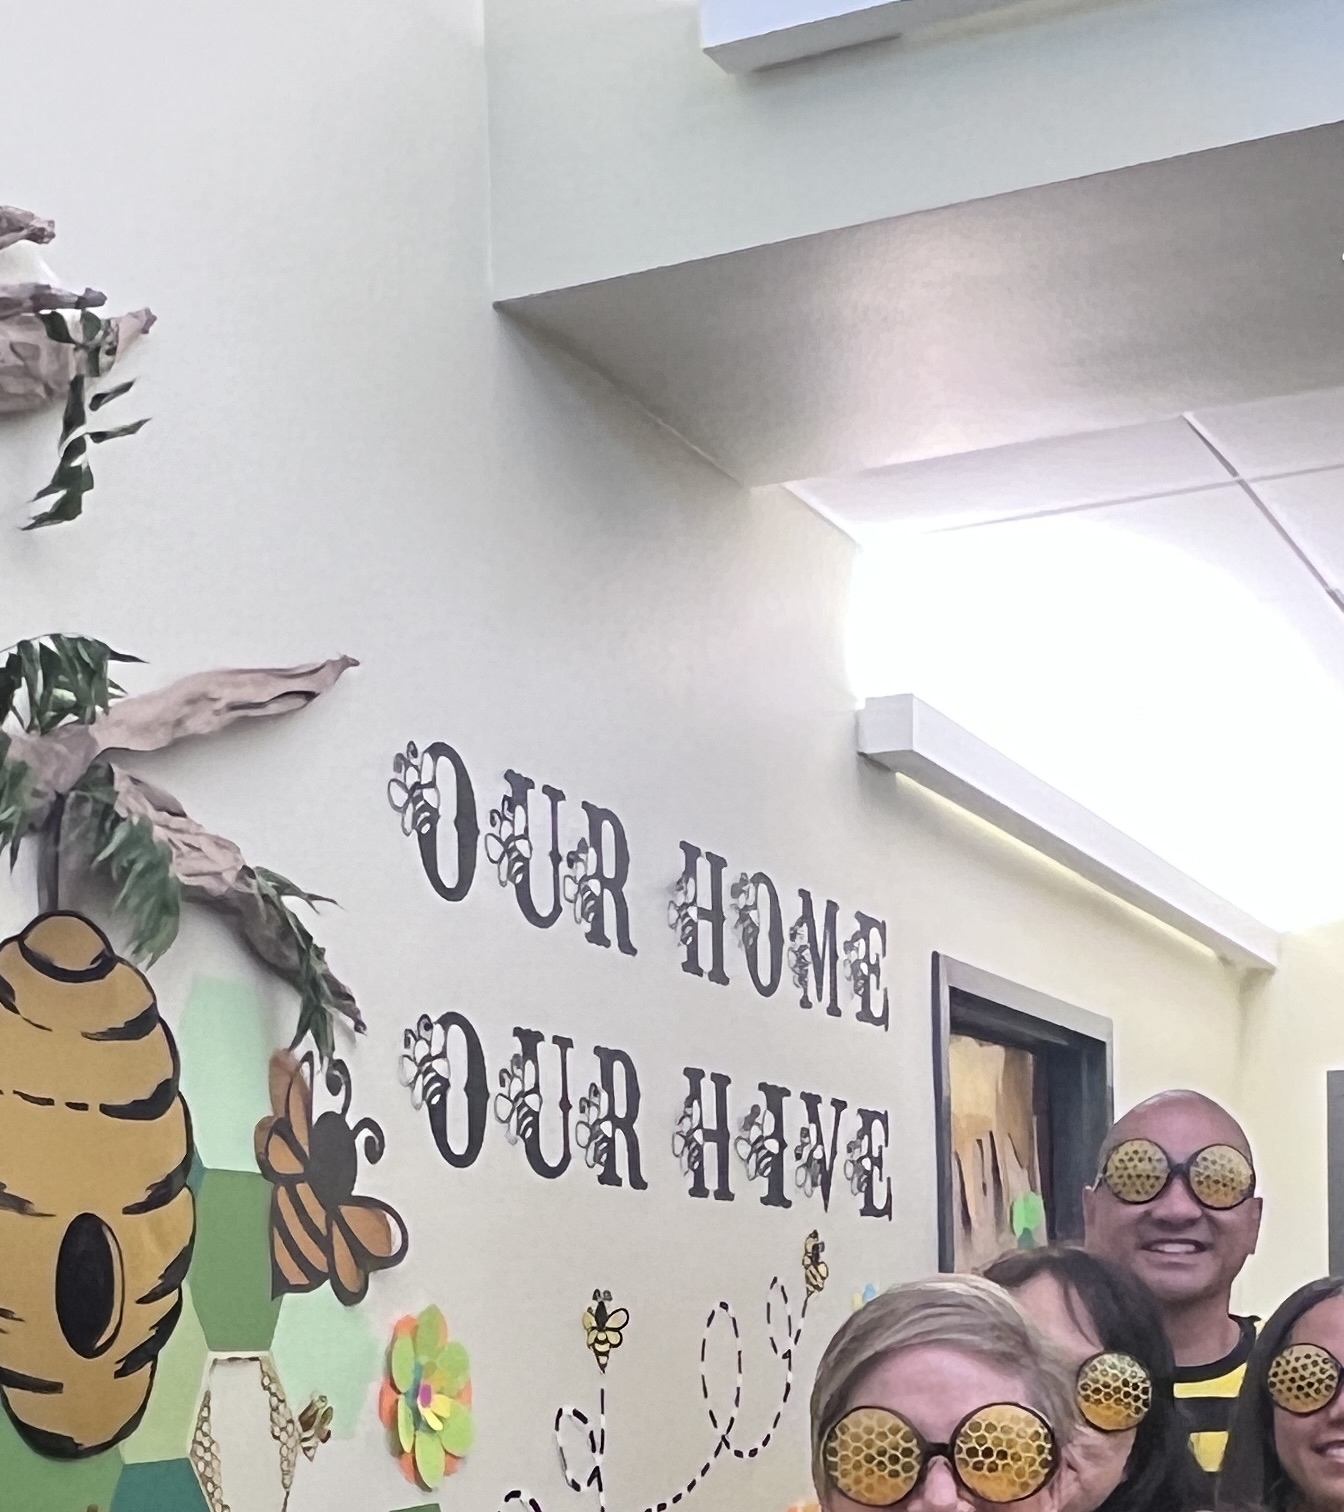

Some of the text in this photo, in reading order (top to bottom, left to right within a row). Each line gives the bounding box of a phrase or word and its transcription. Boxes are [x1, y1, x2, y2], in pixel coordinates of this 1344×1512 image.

[388, 741, 890, 1032] OUR HOME
[399, 1011, 893, 1221] OUR HIVE
